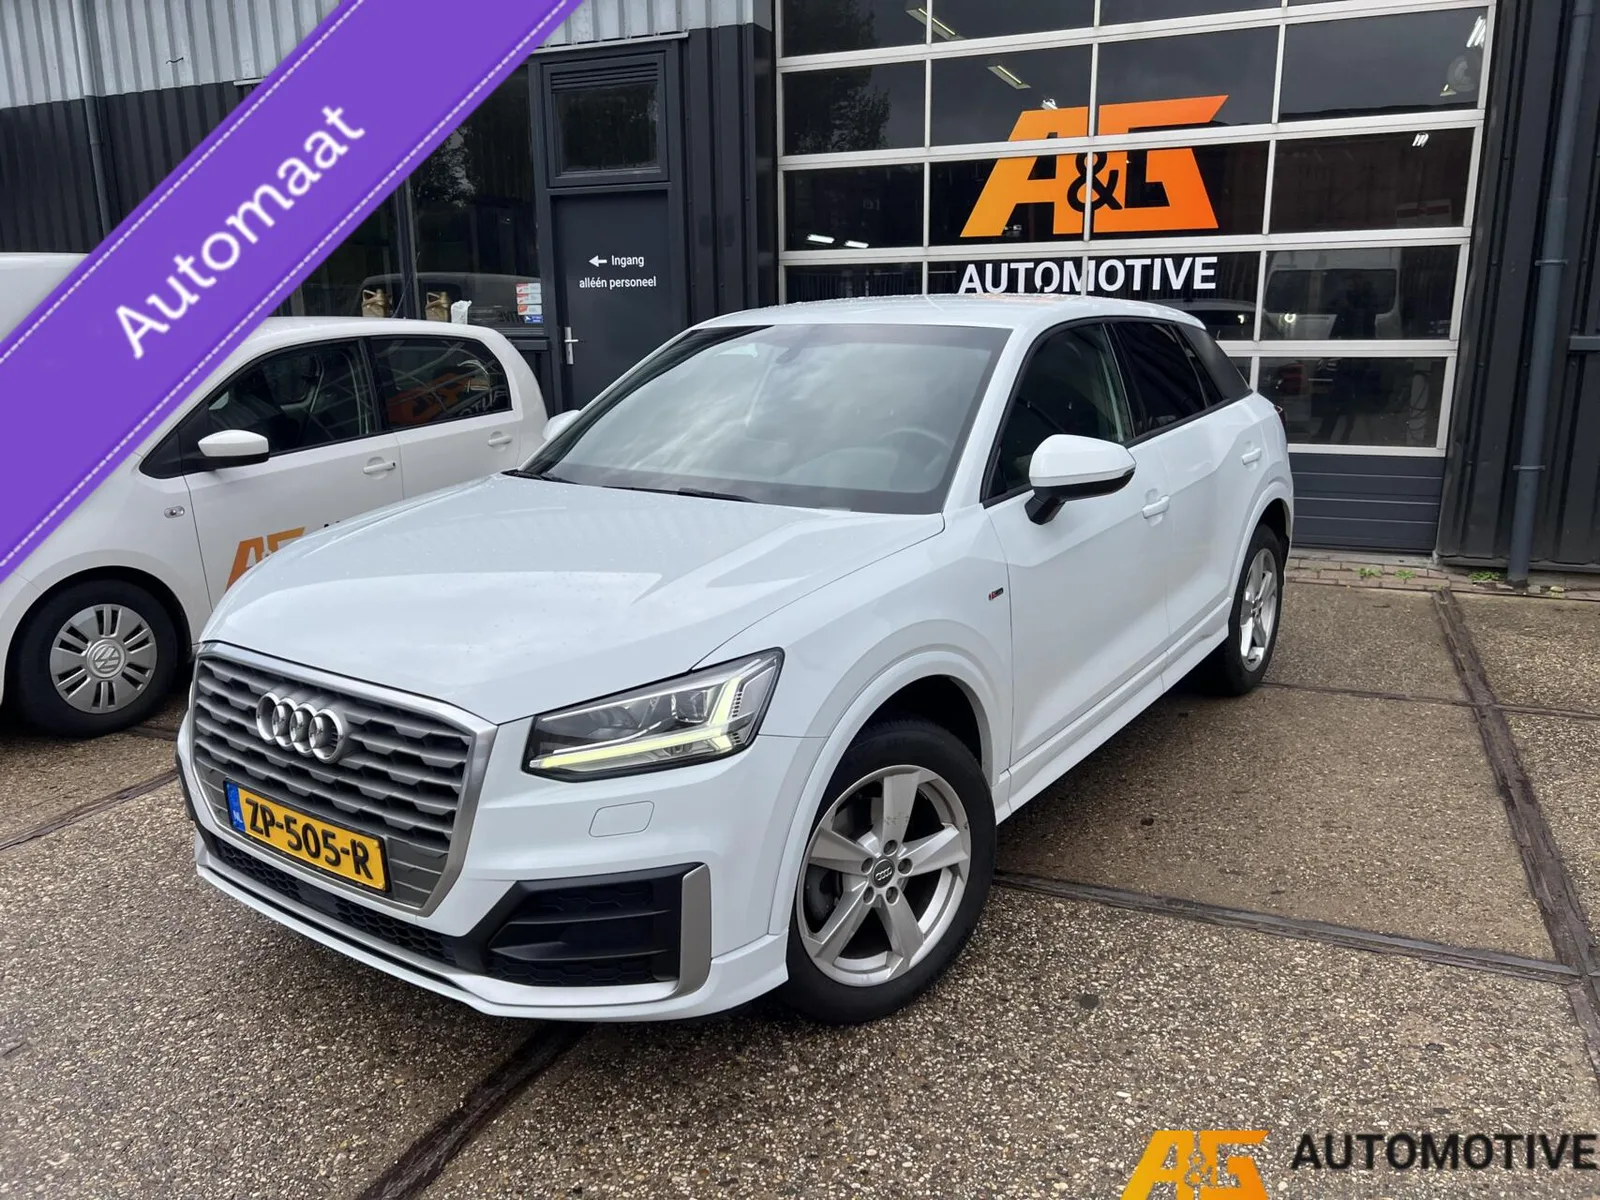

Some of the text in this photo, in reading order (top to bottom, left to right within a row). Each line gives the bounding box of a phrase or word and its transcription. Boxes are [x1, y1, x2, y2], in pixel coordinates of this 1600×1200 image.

[960, 95, 1229, 237] A&G
[612, 256, 644, 267] Ingang
[959, 257, 1218, 294] AUTOMOTIVE
[579, 277, 656, 289] alléén personeel
[246, 797, 373, 879] ZP-505-R
